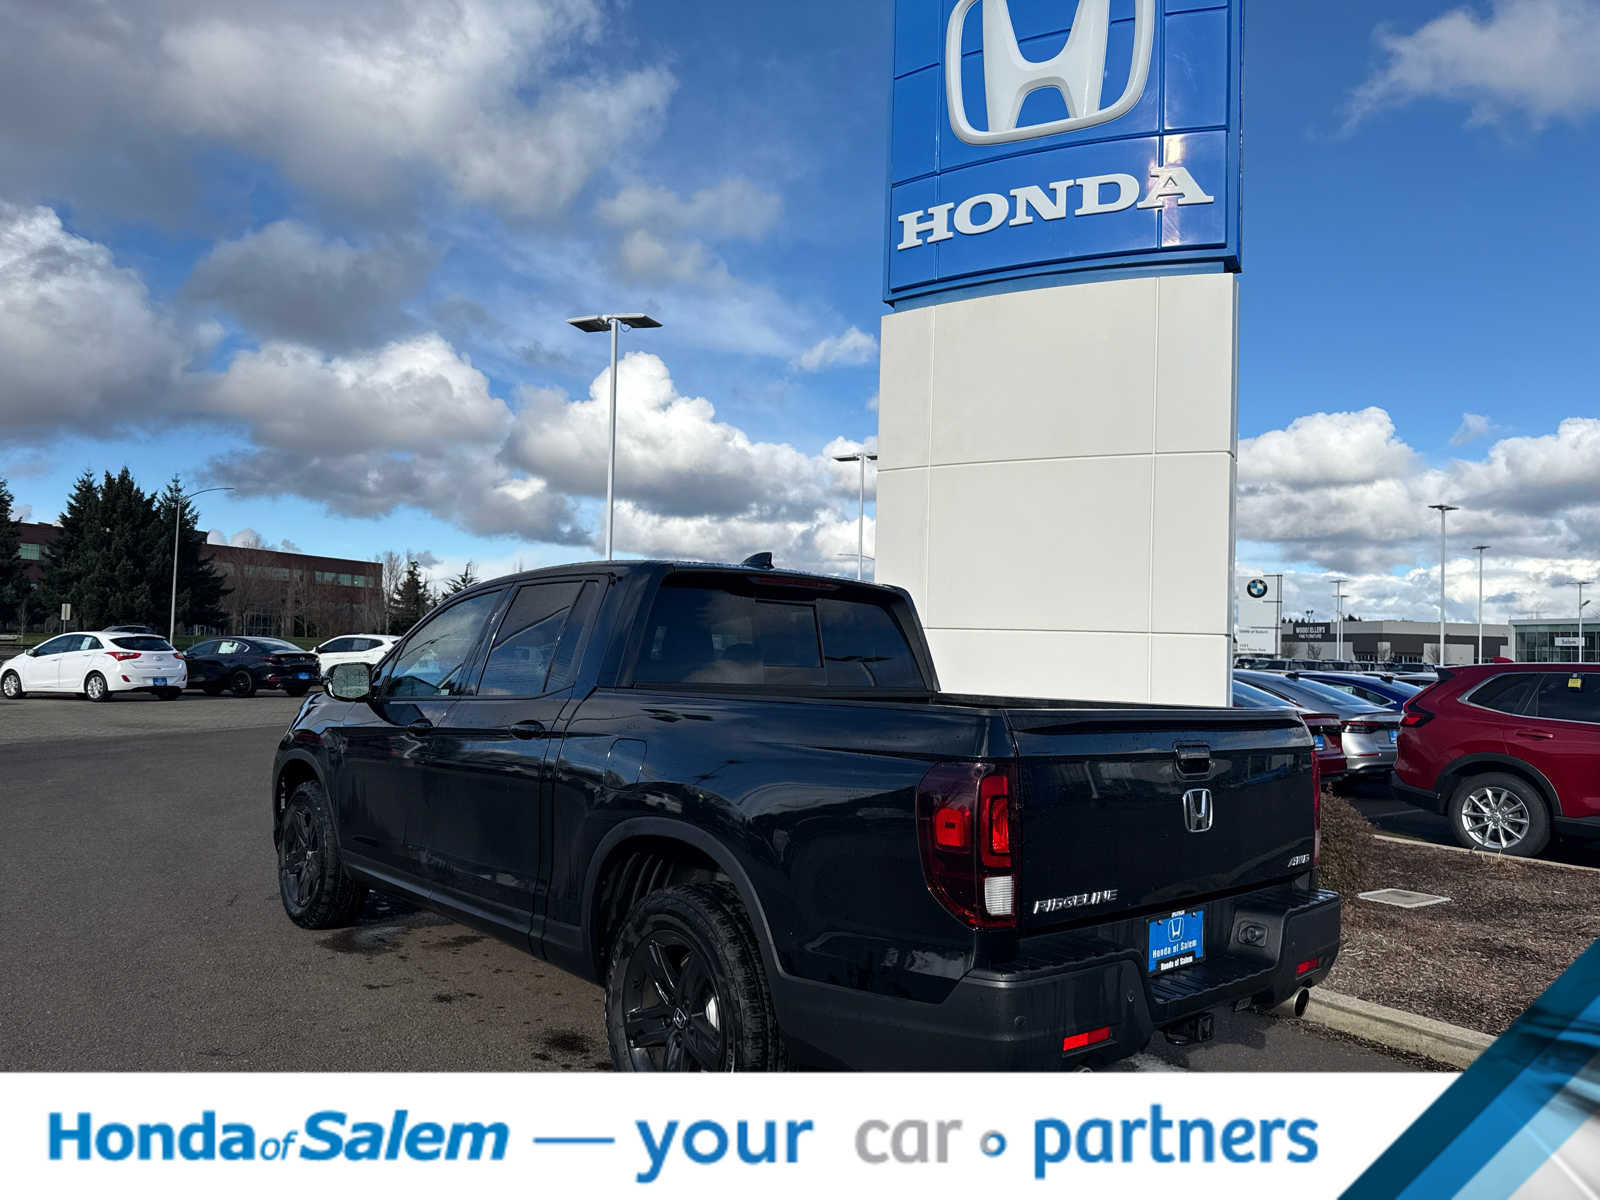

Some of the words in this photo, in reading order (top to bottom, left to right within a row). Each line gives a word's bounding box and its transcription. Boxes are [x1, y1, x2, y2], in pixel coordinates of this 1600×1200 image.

[897, 166, 1214, 250] HONDA
[1033, 889, 1119, 914] RIDGELINE
[1152, 946, 1171, 958] Honda
[1172, 943, 1179, 952] of
[1180, 939, 1197, 950] Salem
